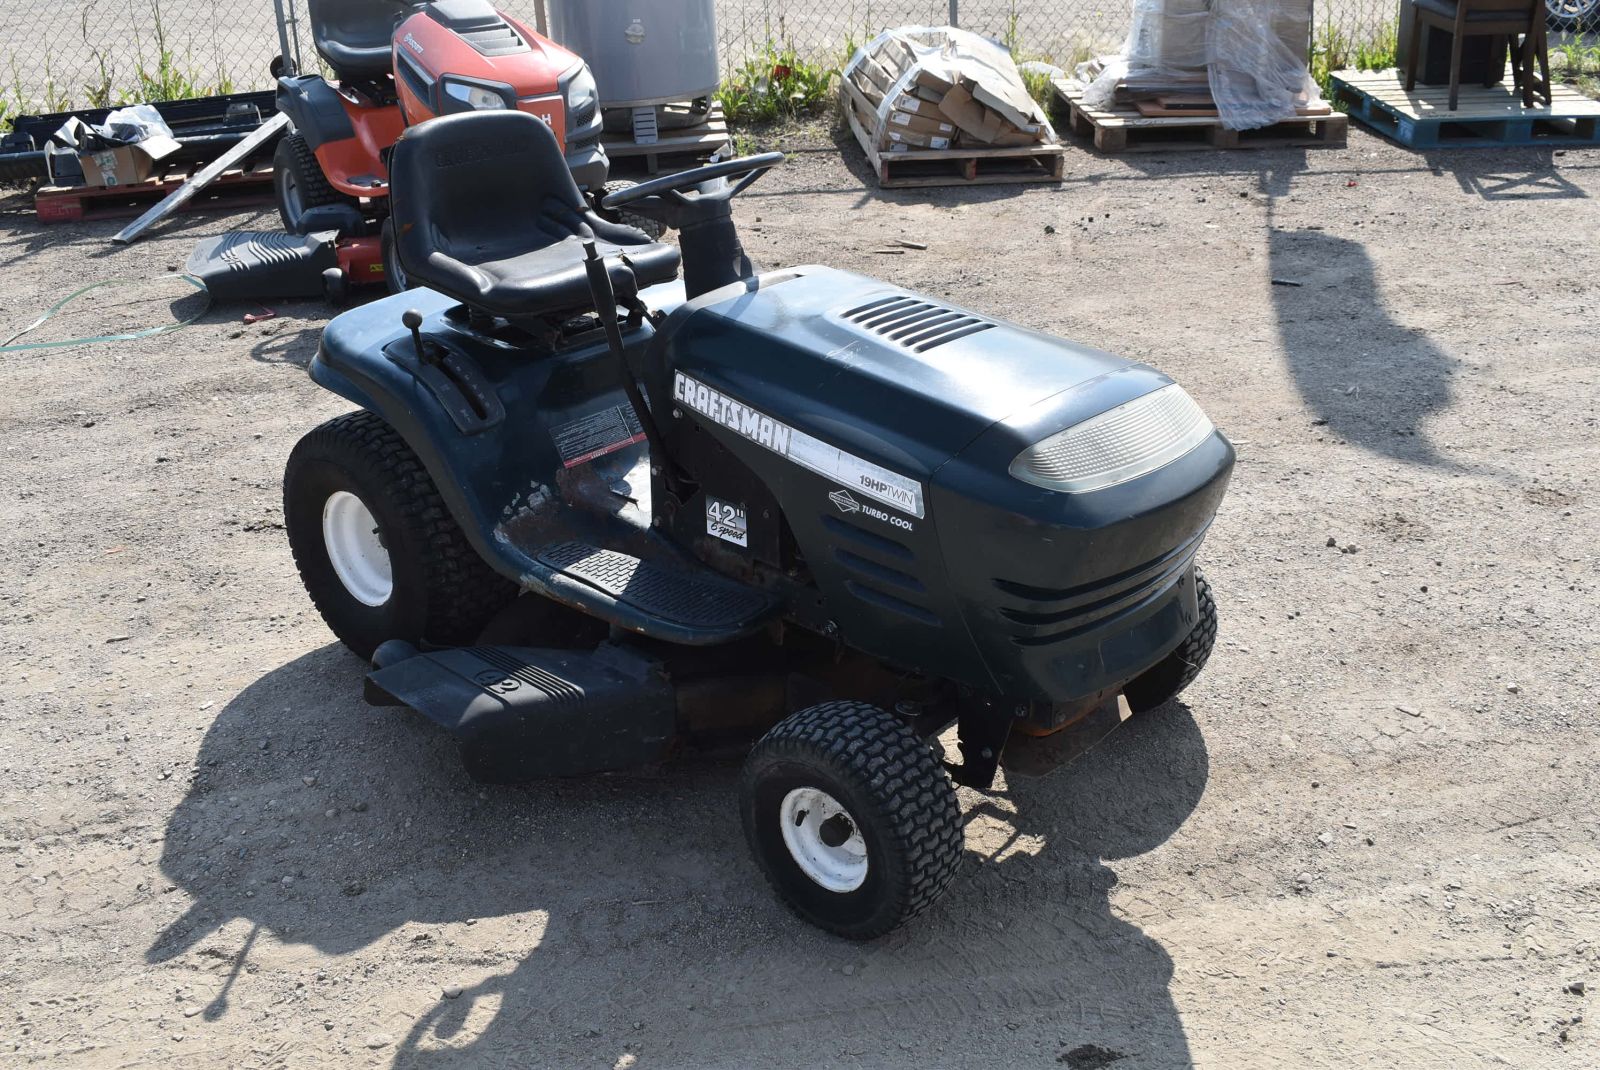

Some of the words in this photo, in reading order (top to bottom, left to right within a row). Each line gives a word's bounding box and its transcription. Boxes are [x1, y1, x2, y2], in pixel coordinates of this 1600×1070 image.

[674, 373, 789, 455] CRAFTSMAN
[709, 501, 744, 528] 42"
[861, 504, 888, 521] TURBO
[890, 516, 913, 531] COOL
[711, 523, 718, 531] 6
[718, 526, 746, 540] speed
